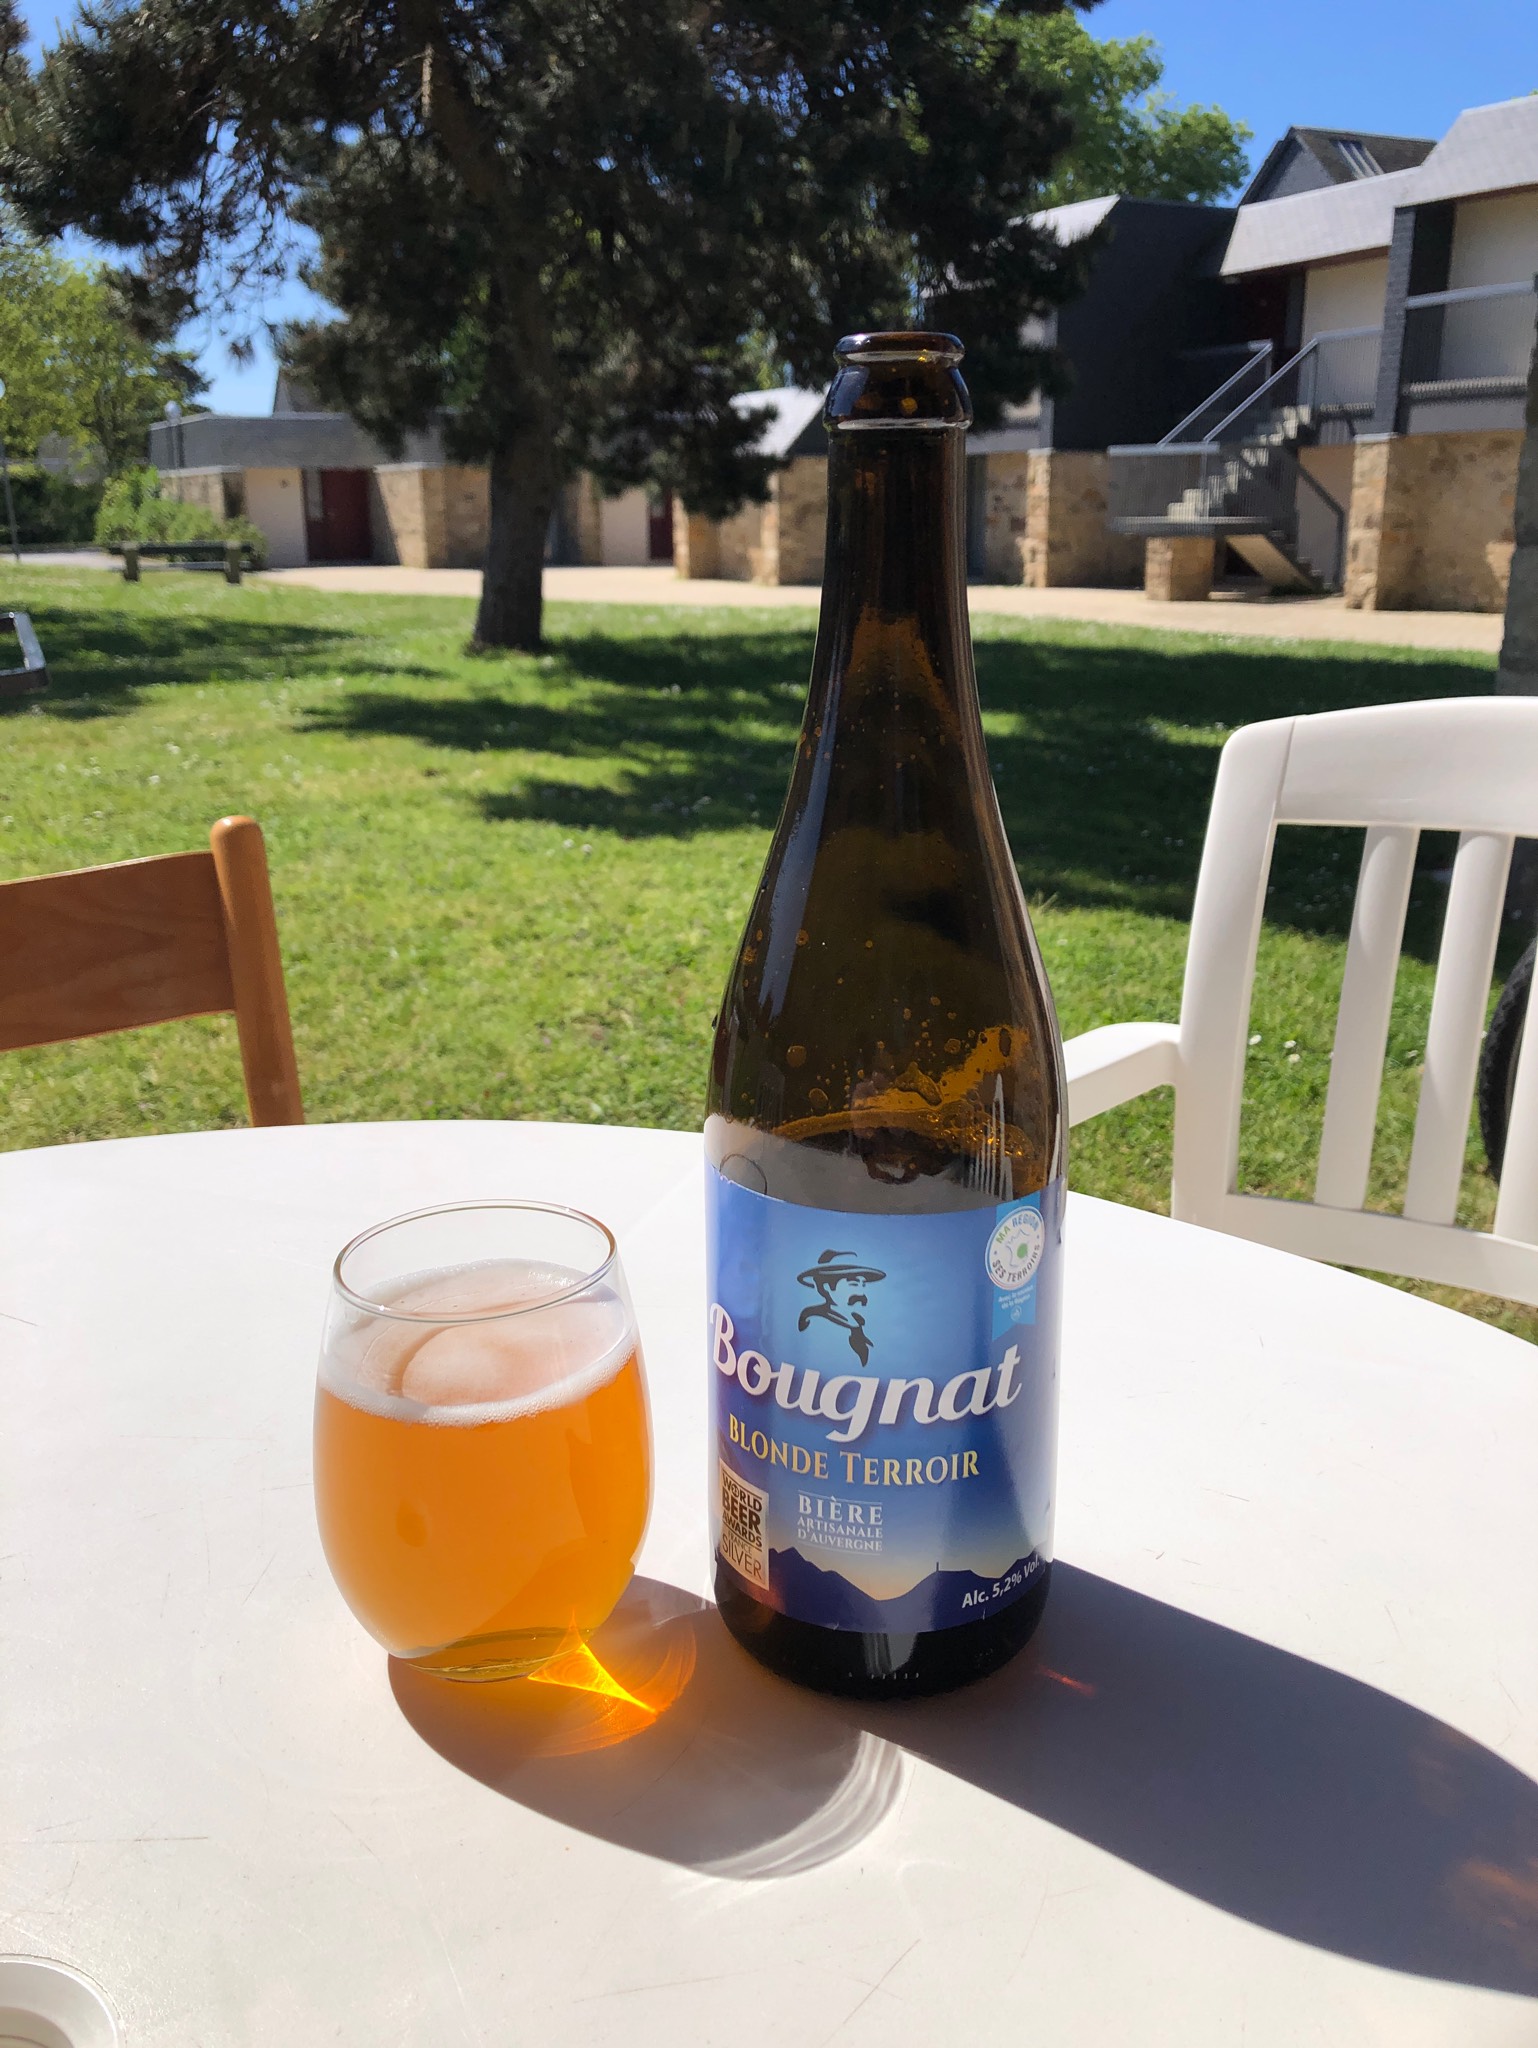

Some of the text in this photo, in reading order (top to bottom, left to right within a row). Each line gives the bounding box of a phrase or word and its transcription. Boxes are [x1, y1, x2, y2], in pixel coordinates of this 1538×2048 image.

[996, 1225, 1011, 1243] MA
[992, 1244, 1040, 1282] SES TERROIRS
[710, 1302, 1022, 1443] Bougnat
[729, 1413, 980, 1486] BLONDE TERROIR
[723, 1472, 762, 1512] WORLD
[798, 1494, 883, 1525] BIÈRE
[722, 1490, 761, 1535] BEER
[722, 1510, 762, 1548] AWARDS
[797, 1516, 883, 1538] ARTISANALE
[723, 1534, 762, 1579] SILVER
[728, 1530, 752, 1555] FRANCE
[797, 1528, 883, 1551] D'AUVERGNE
[962, 1554, 1040, 1608] Alc. 5,2% Vol.
